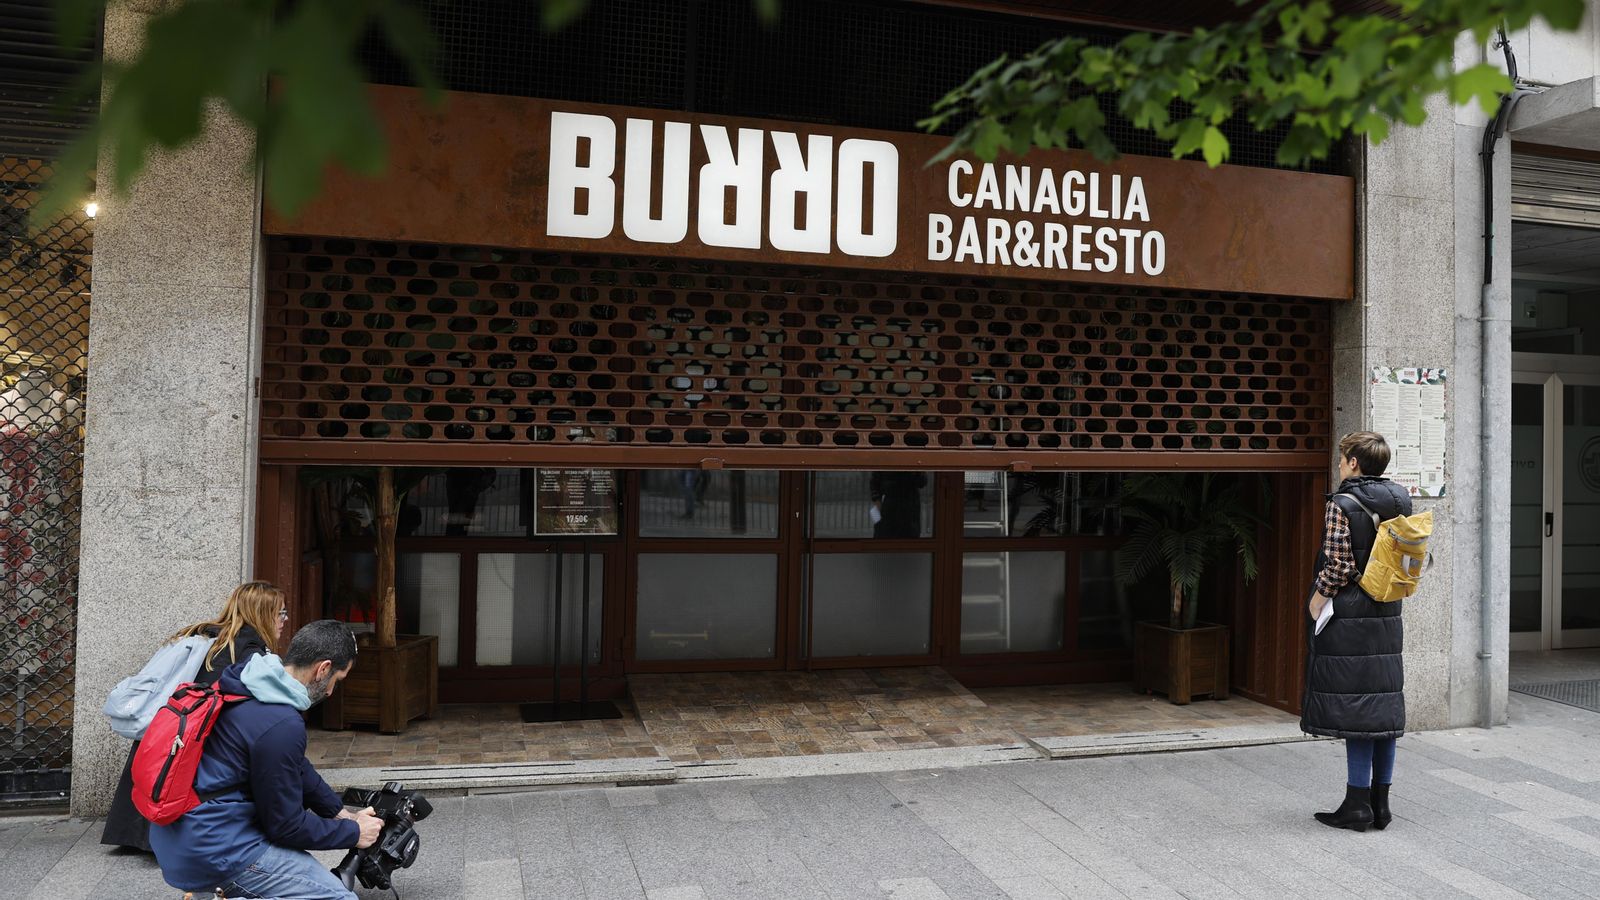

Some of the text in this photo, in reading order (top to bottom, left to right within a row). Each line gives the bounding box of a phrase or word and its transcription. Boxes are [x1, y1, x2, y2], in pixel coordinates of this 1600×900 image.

[547, 112, 899, 258] BURRO
[948, 159, 1151, 222] CANAGLIA
[927, 213, 1166, 276] BAR&RESTO
